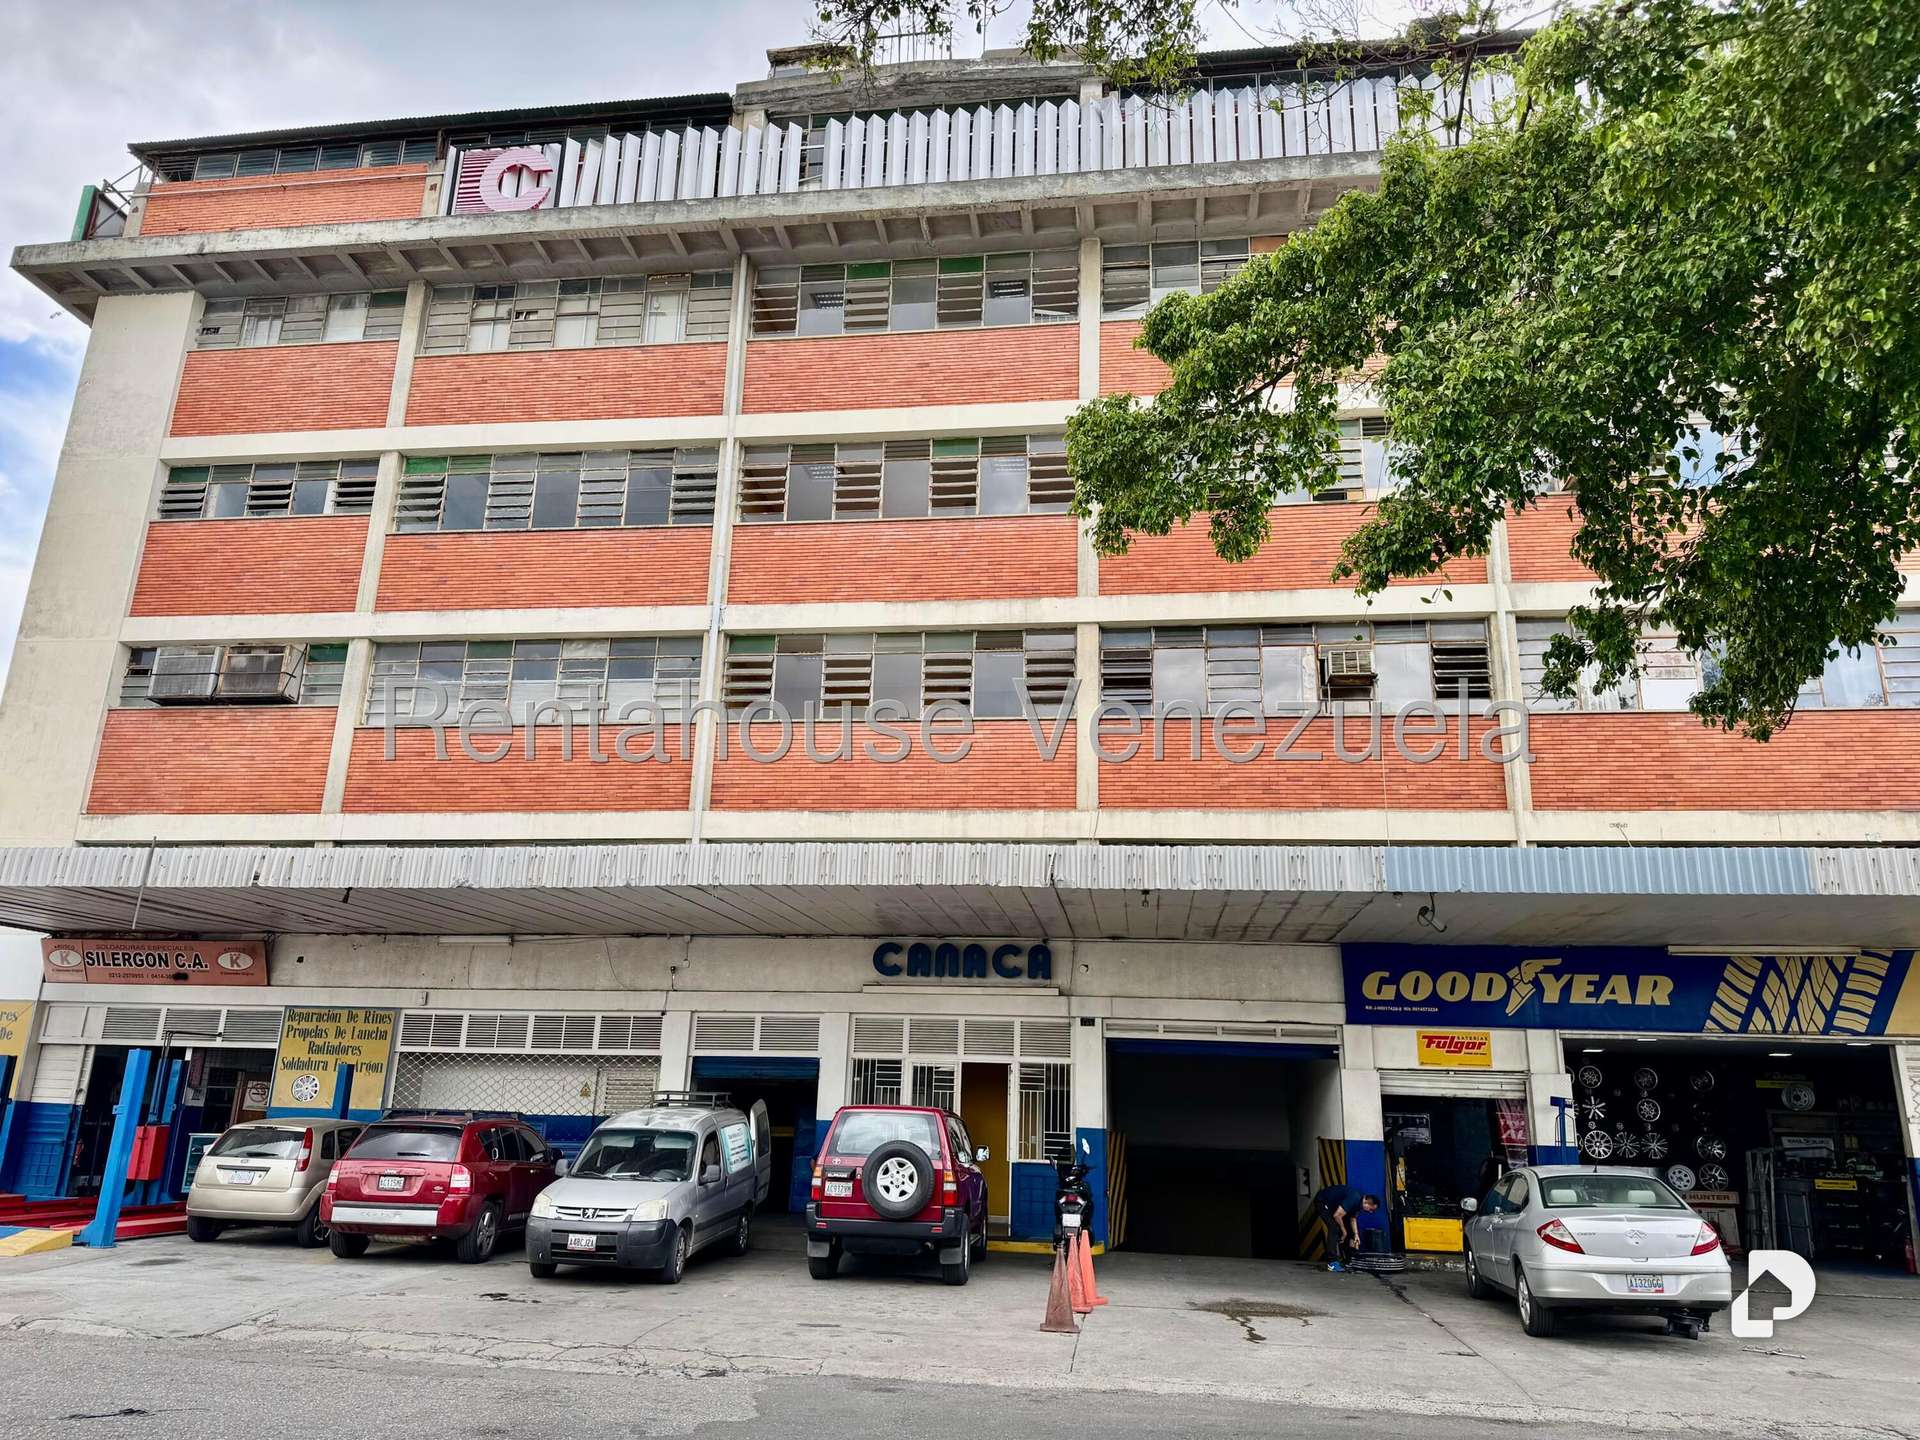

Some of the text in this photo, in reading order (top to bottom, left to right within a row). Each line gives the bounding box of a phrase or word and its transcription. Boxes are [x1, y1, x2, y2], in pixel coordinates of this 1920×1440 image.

[85, 951, 209, 969] SILERGON C.A.
[873, 942, 1052, 979] CANACA
[287, 1009, 392, 1024] Reparación De Rines
[286, 1025, 388, 1041] Propelas De Lancha
[308, 1041, 362, 1056] Radiadores
[281, 1056, 328, 1071] Soldadura
[1689, 1193, 1731, 1201] HUNTER
